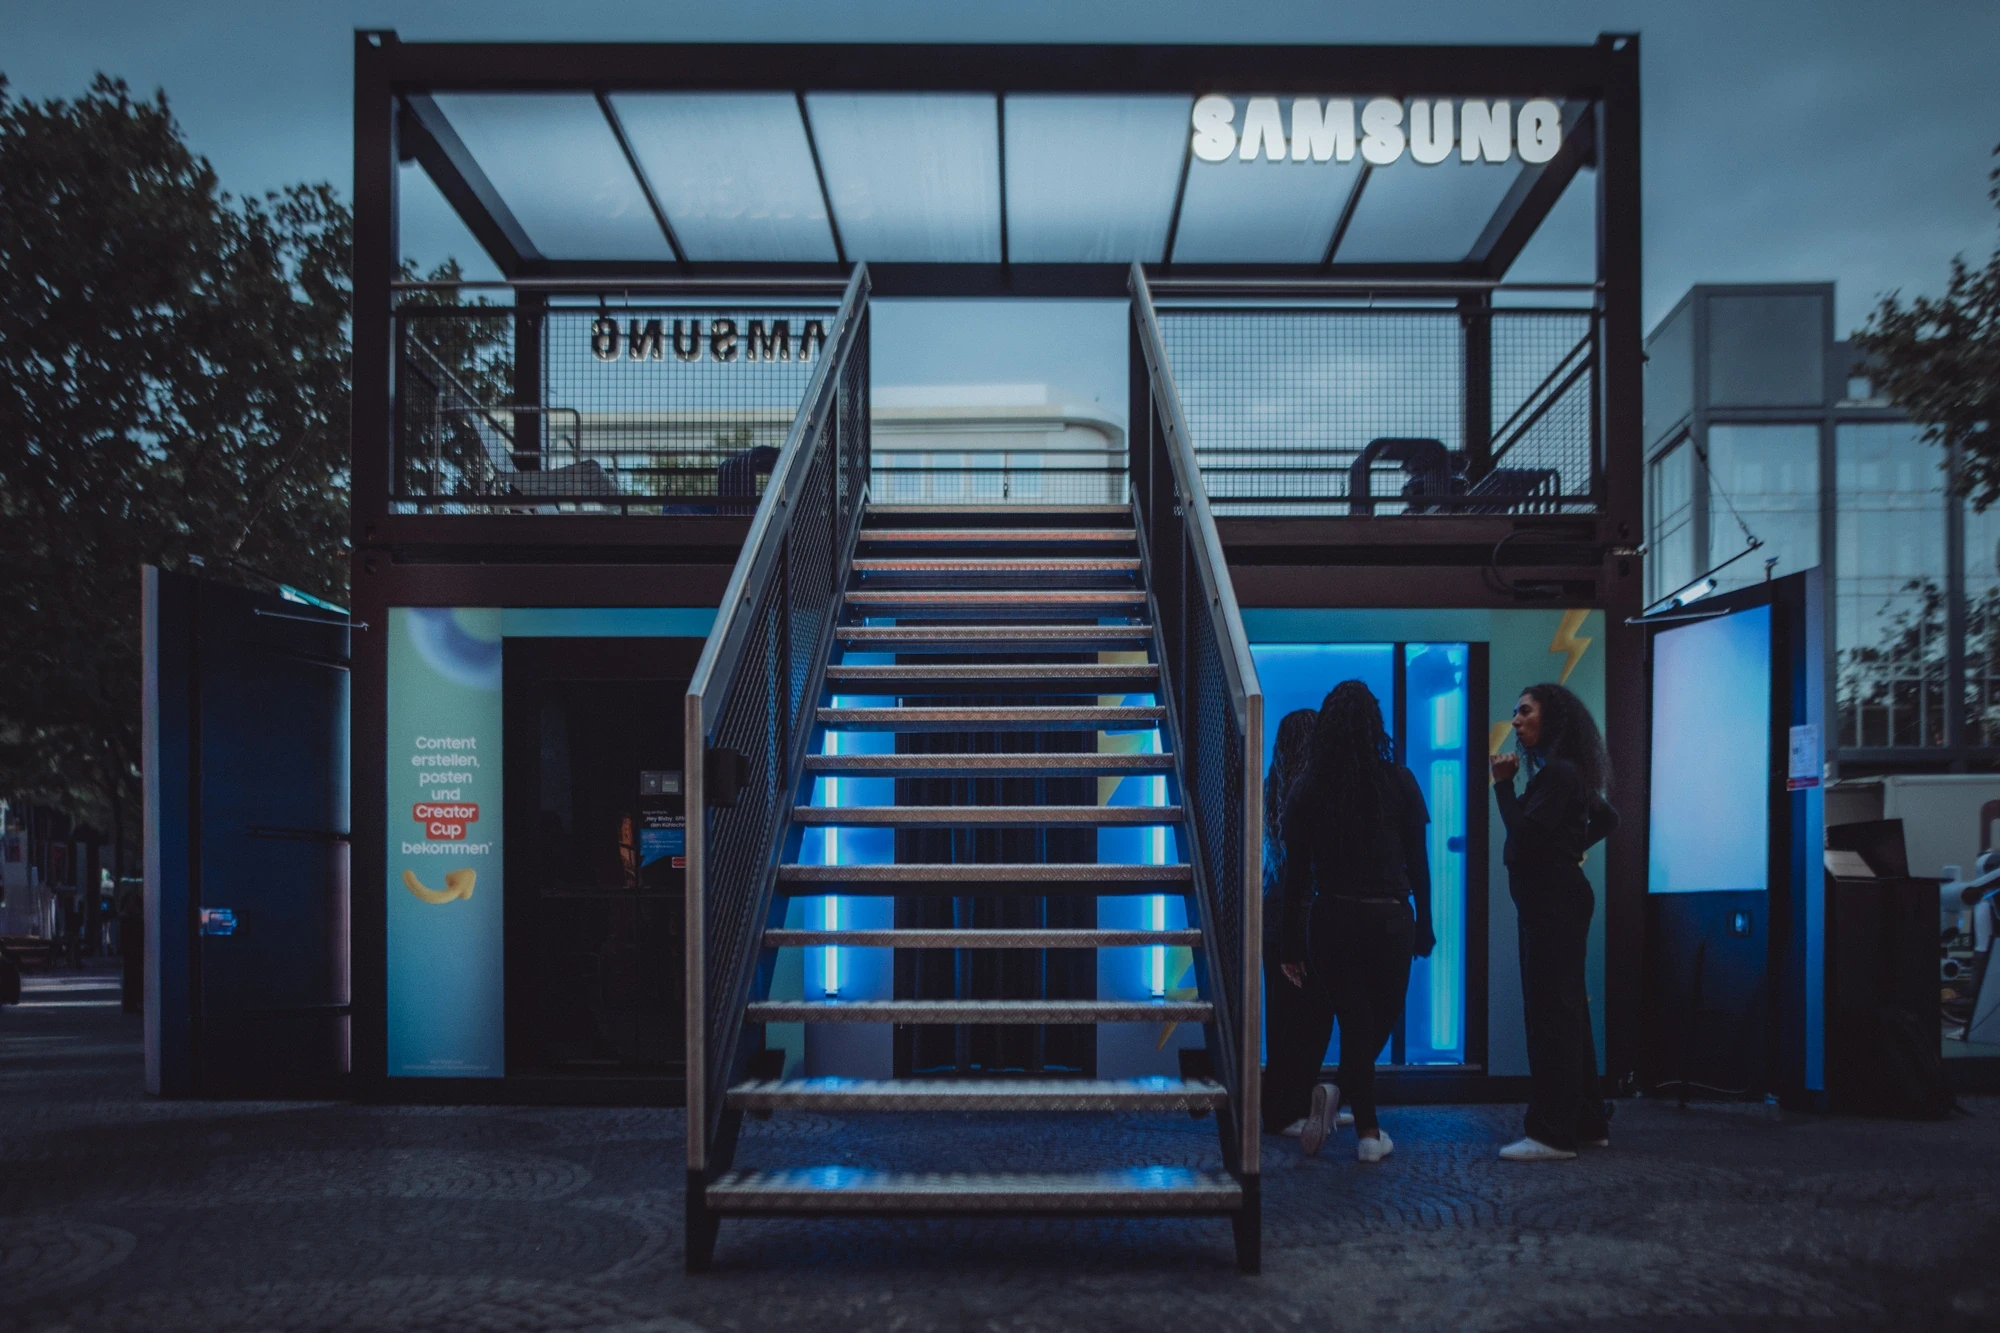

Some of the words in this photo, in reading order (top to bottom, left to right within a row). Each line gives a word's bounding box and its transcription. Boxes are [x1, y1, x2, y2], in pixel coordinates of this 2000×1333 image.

[1192, 95, 1563, 165] SAMSUNG
[416, 736, 477, 750] Content
[411, 754, 480, 768] erstellen,
[420, 771, 472, 787] posten
[431, 788, 461, 801] und
[416, 805, 475, 819] Creator
[430, 822, 462, 839] Cup
